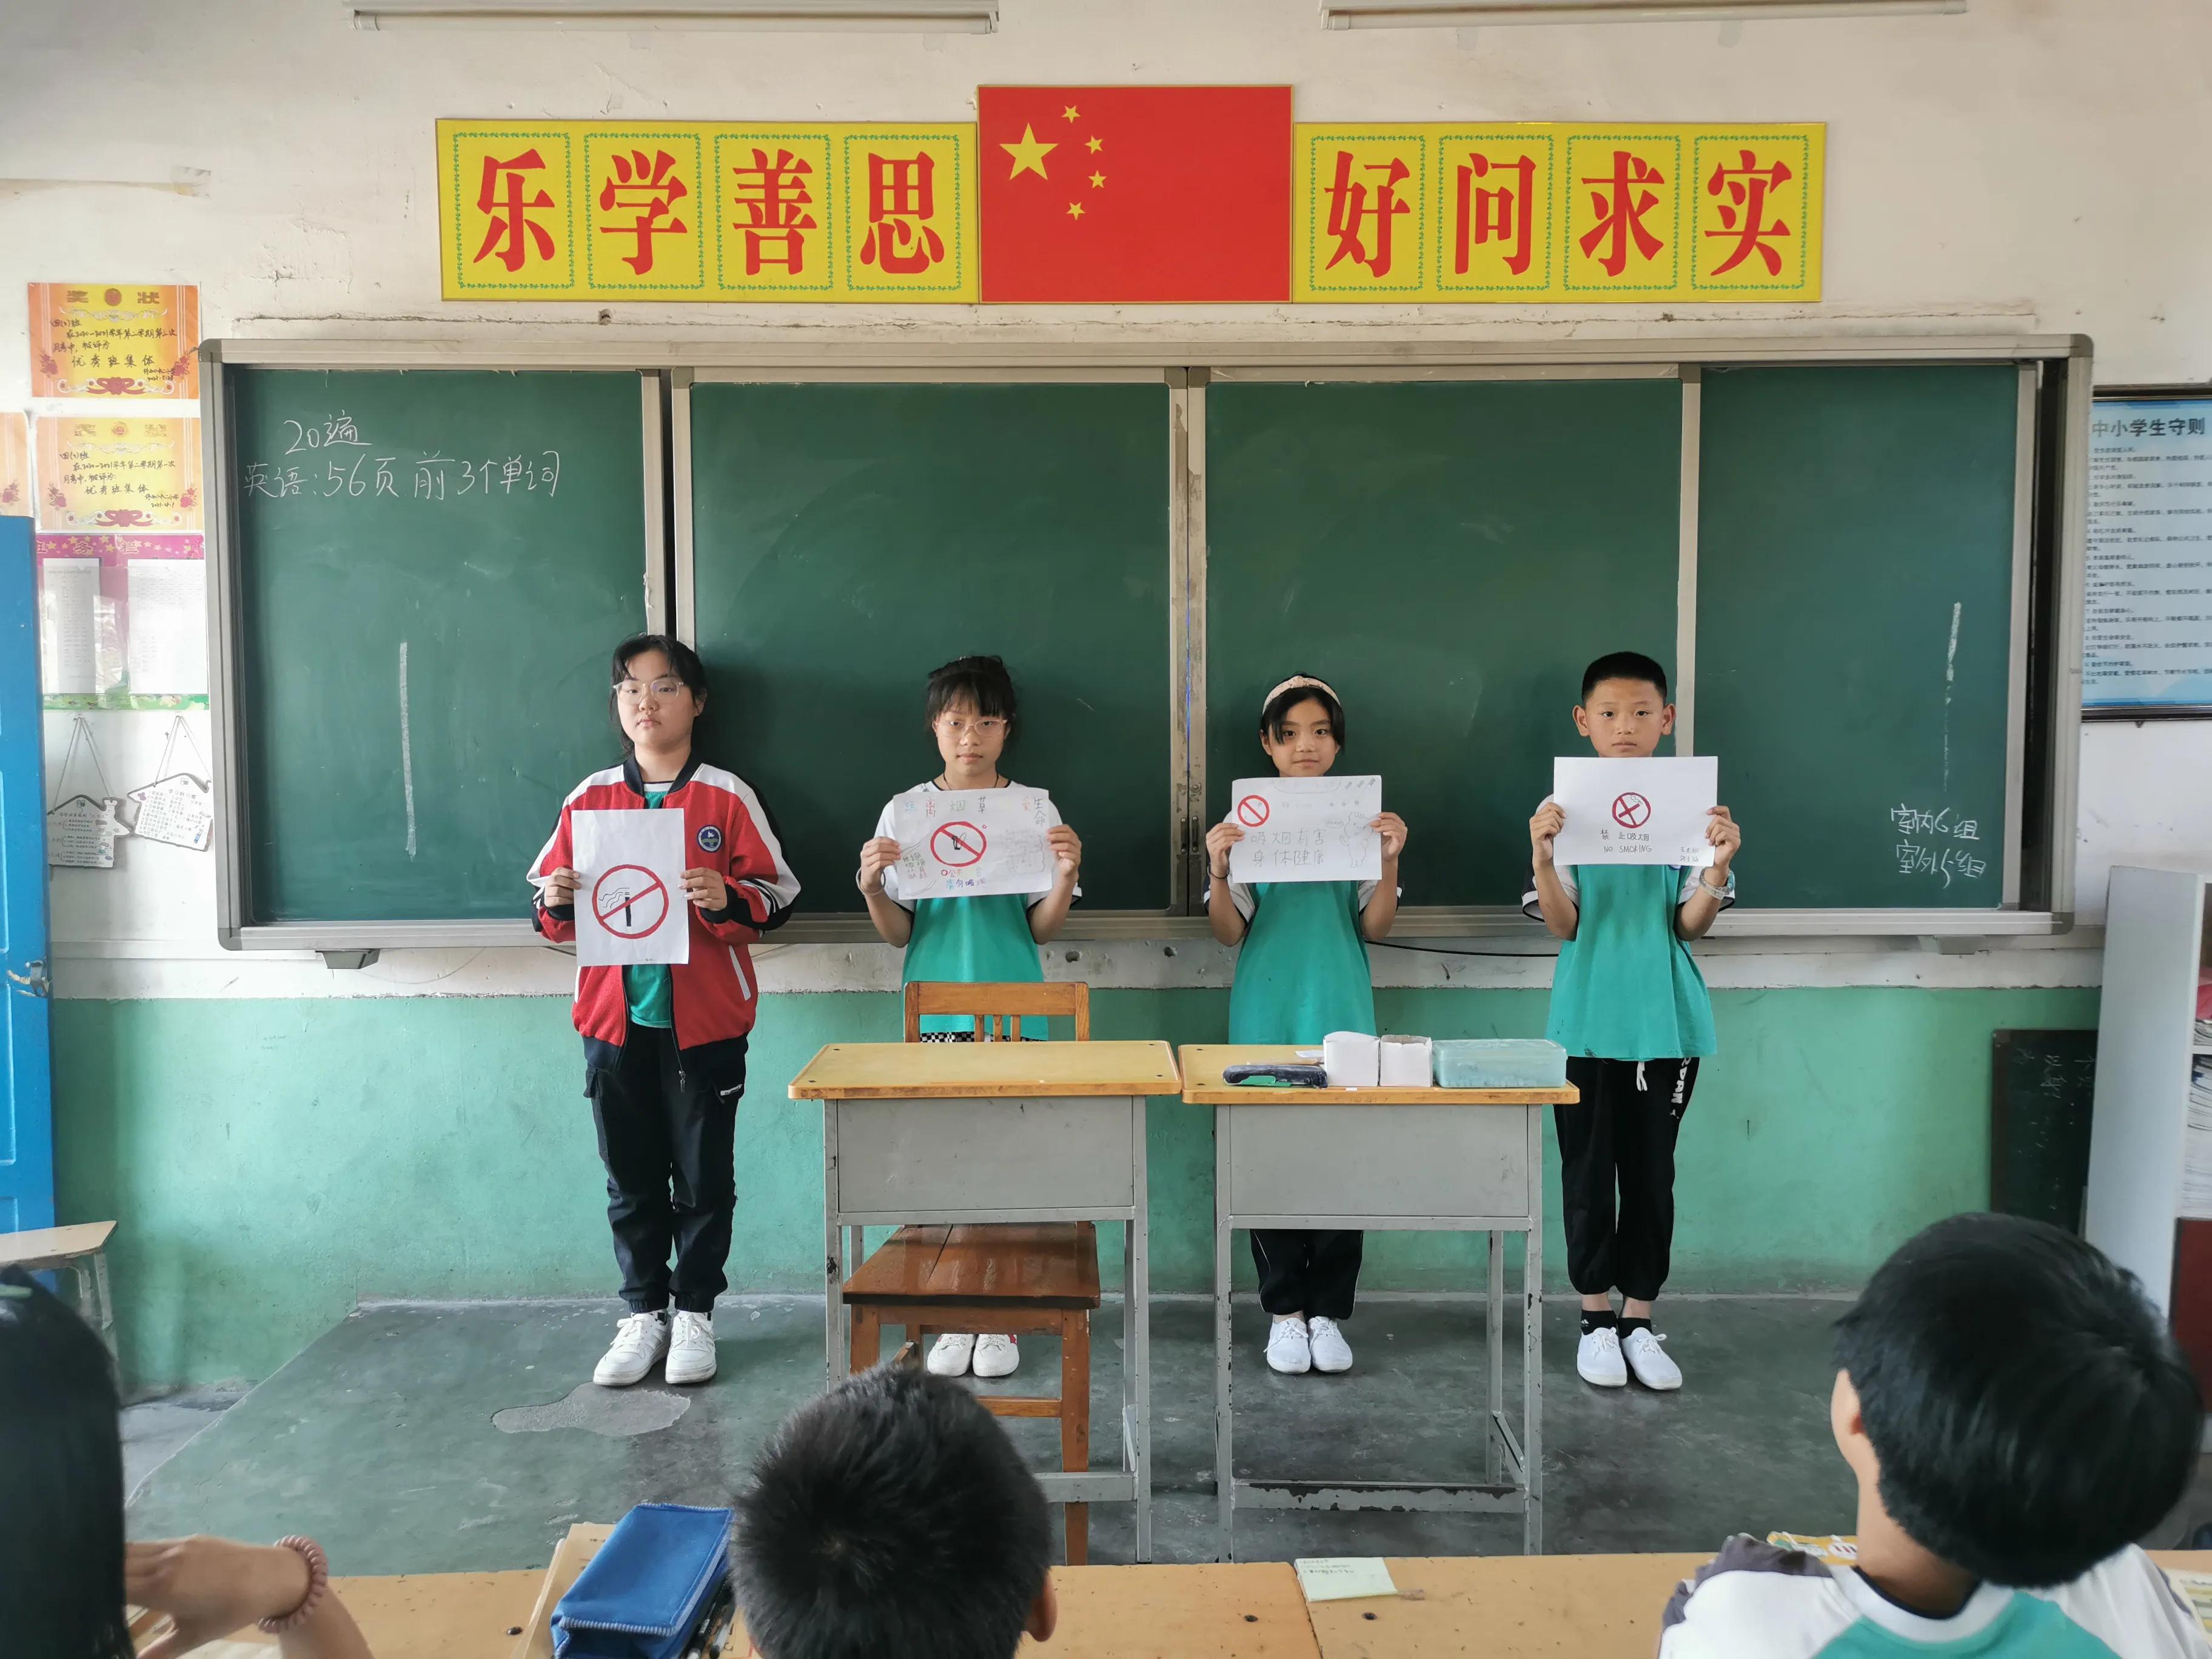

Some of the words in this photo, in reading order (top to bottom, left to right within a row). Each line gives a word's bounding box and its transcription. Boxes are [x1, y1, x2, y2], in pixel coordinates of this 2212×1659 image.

[472, 148, 944, 276] 乐学善思
[1324, 149, 1791, 278] 好问求实
[72, 354, 155, 368] 优秀班集体
[284, 409, 372, 454] 20遍
[2092, 417, 2205, 438] 中小学生守则
[85, 483, 149, 495] 优秀班集体
[1891, 803, 1980, 840] 室内6组
[1251, 826, 1327, 846] 吸烟有害
[1600, 829, 1649, 842] 禁止吸烟
[1252, 849, 1325, 868] 身体健康
[1620, 843, 1652, 854] SMOKING
[1896, 839, 1987, 890] 室外5组
